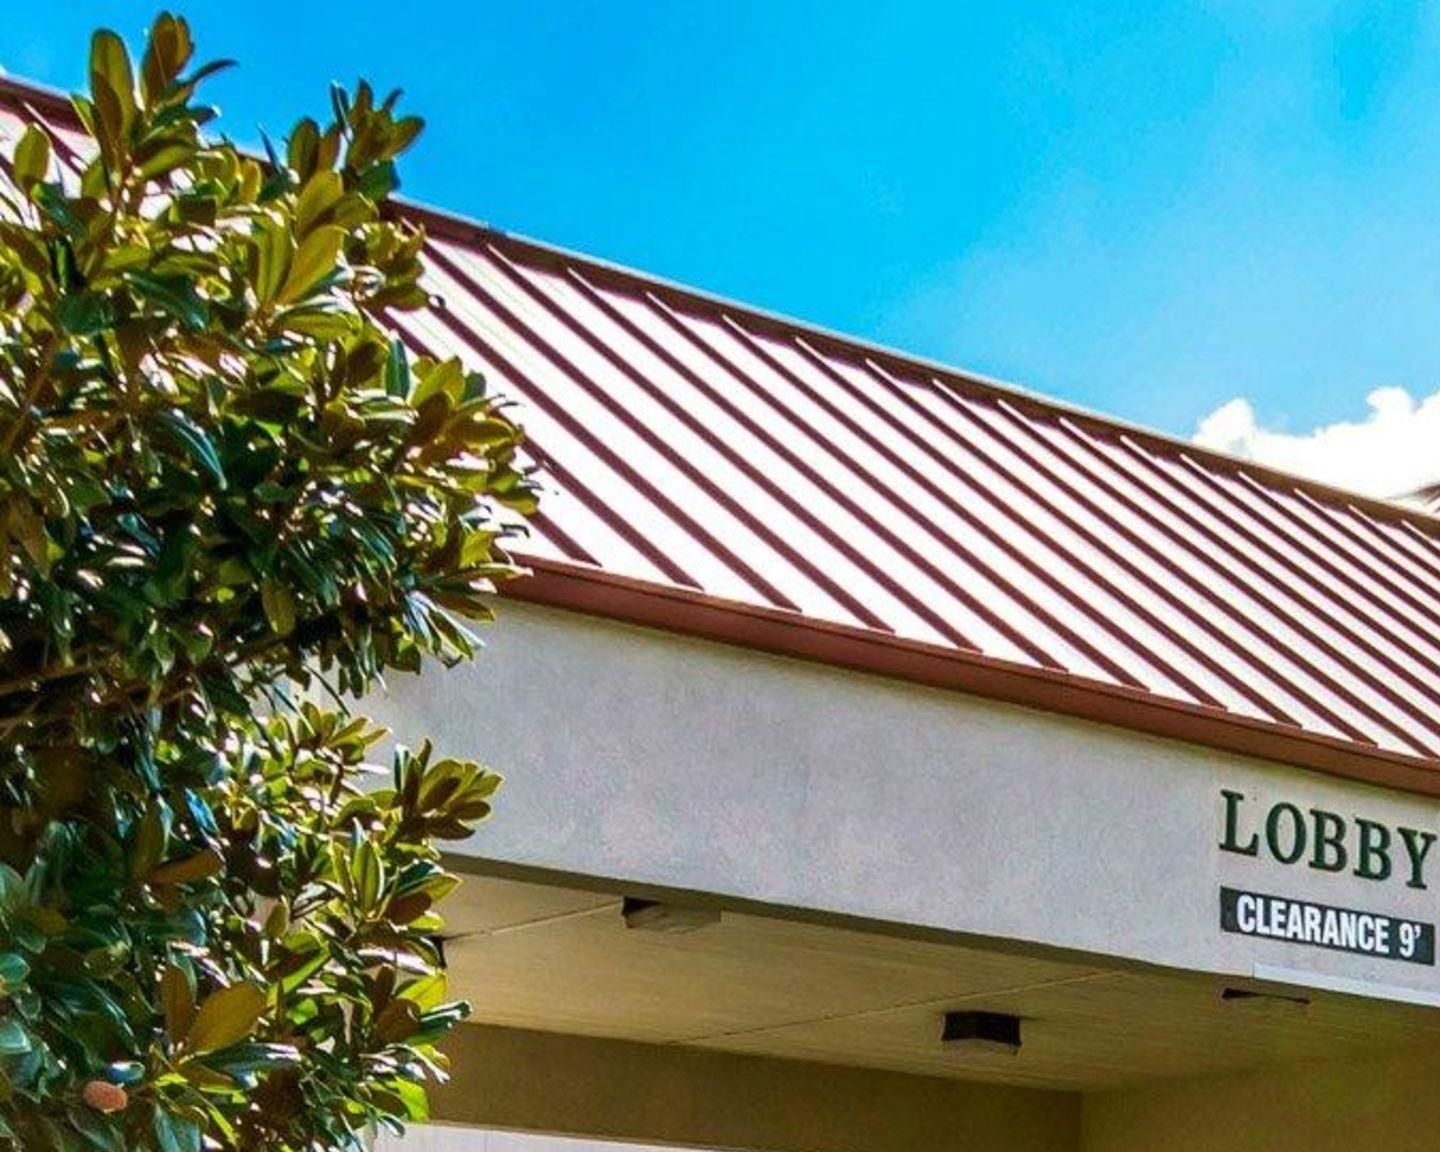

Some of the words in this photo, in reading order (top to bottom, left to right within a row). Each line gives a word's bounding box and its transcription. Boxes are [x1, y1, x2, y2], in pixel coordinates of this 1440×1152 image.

[1219, 789, 1437, 890] LOBBY
[1237, 894, 1390, 953] CLEARANCE
[1399, 922, 1421, 958] 9'
